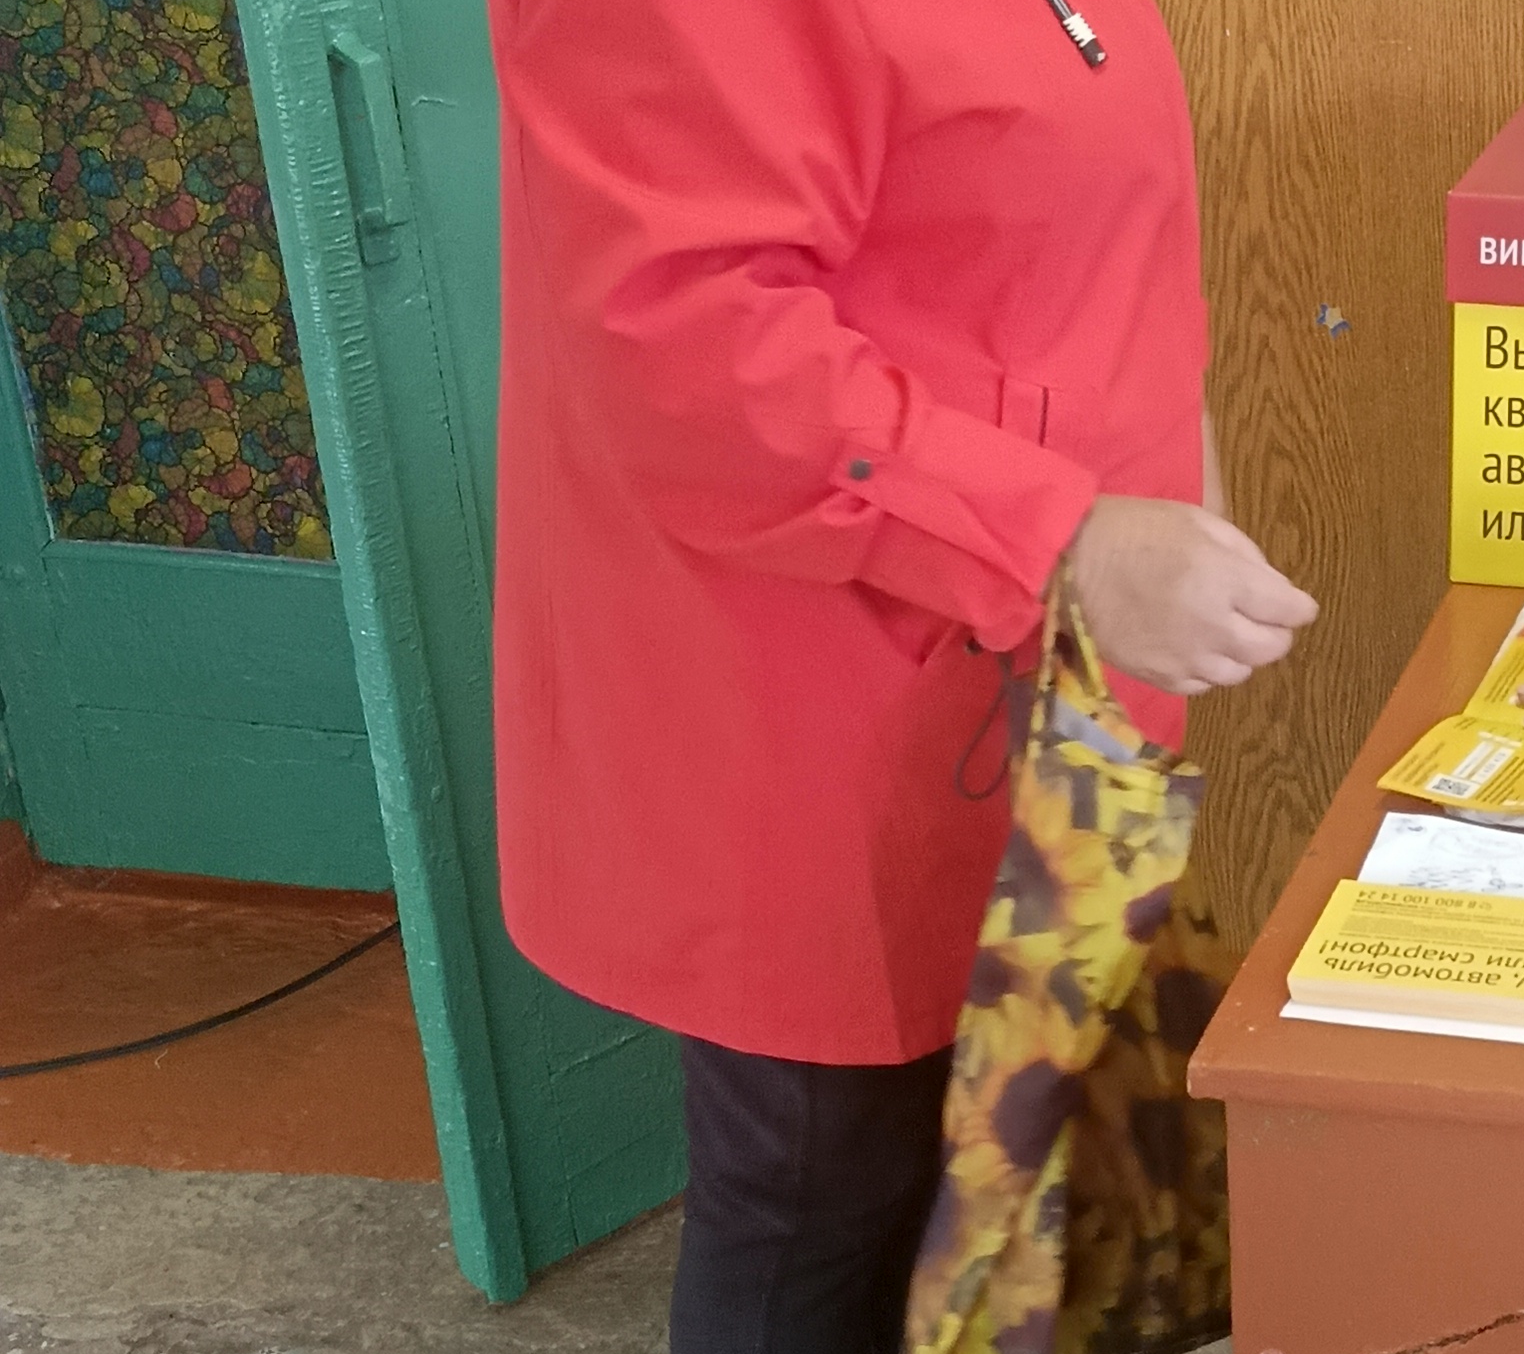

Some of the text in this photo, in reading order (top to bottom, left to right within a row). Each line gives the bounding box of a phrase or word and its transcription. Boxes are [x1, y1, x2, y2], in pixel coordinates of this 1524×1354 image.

[1358, 890, 1378, 899] 24
[1381, 891, 1398, 901] 14
[1403, 893, 1431, 904] 100
[1318, 938, 1475, 965] смартфон!
[1323, 957, 1501, 986] автомобиль
